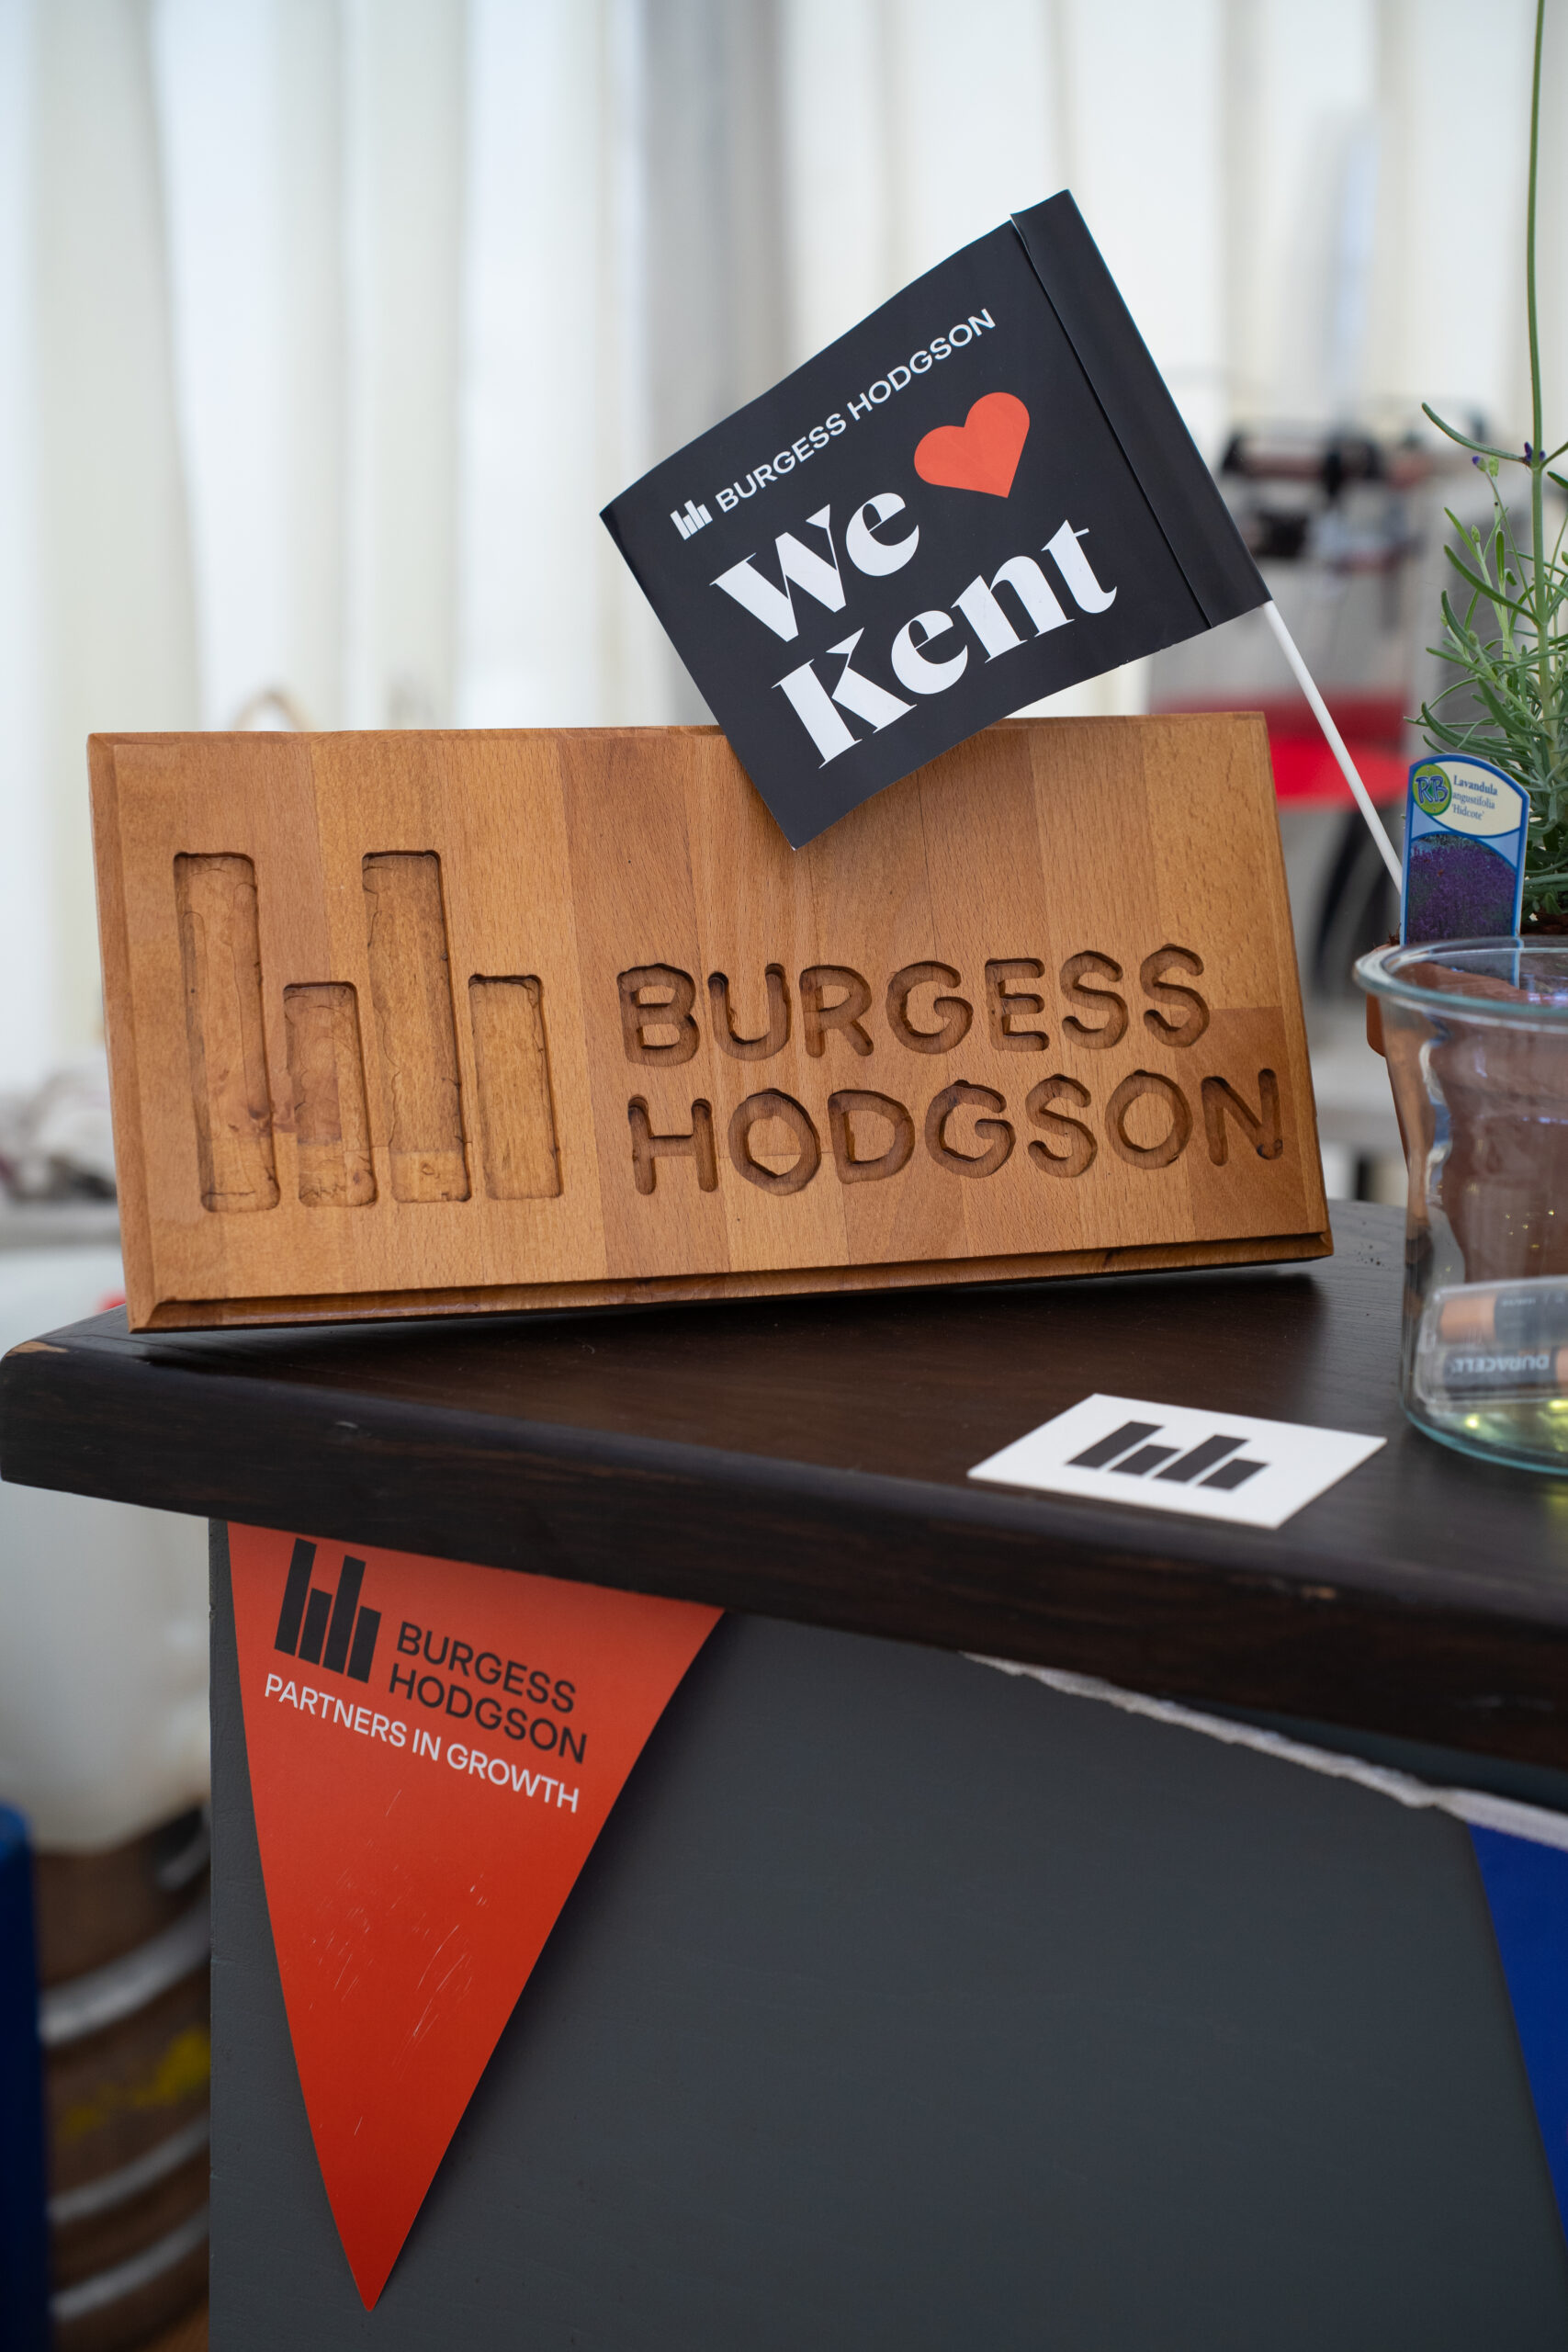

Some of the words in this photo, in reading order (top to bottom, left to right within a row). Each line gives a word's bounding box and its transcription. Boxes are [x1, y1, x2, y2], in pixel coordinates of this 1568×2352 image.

[715, 413, 847, 513] BURGESS
[846, 308, 997, 421] HODGSON
[709, 492, 919, 643] We
[771, 518, 1118, 769] Kent
[1416, 775, 1449, 804] RB
[1452, 792, 1495, 809] angustifolia
[1453, 775, 1498, 795] Lavandula
[616, 944, 1210, 1067] BURGESS
[627, 1068, 1283, 1195] HODGSON
[389, 1663, 588, 1764] HODGSON
[396, 1621, 577, 1713] BURGESS
[265, 1673, 407, 1747] PARTNERS
[412, 1728, 442, 1761] IN
[446, 1743, 580, 1814] GROWTH
